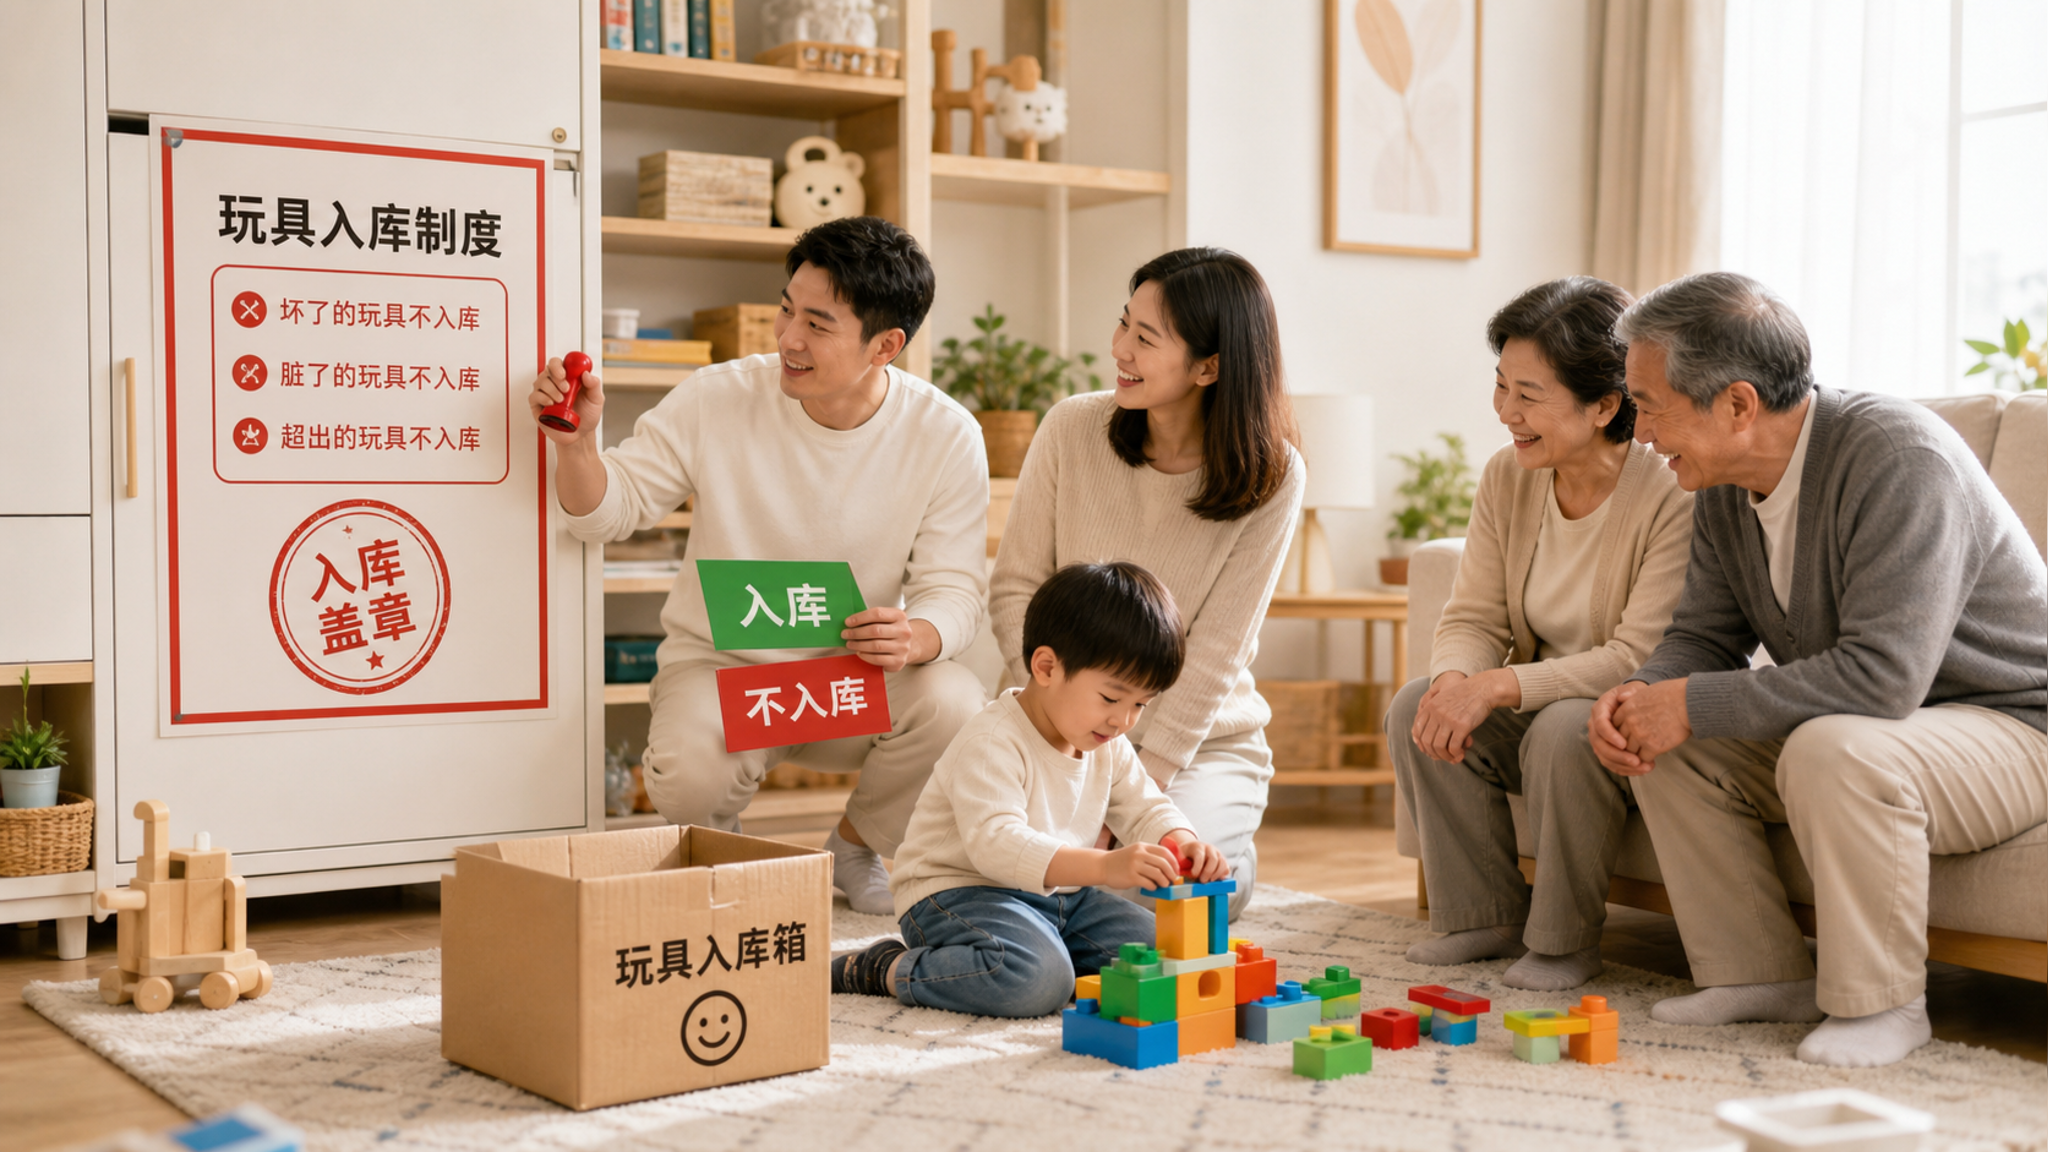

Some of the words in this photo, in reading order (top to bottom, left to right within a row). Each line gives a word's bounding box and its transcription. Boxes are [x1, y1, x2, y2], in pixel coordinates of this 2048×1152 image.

[218, 194, 502, 258] 玩具入库制度
[280, 297, 480, 331] 坏了的玩具不入库
[280, 361, 480, 392] 脏了的玩具不入库
[281, 423, 481, 452] 超出的玩具不入库
[310, 539, 405, 603] 入库
[318, 592, 417, 656] 盖章
[740, 583, 831, 628] 入库
[745, 676, 868, 727] 不入库
[615, 921, 807, 989] 玩具入库箱
